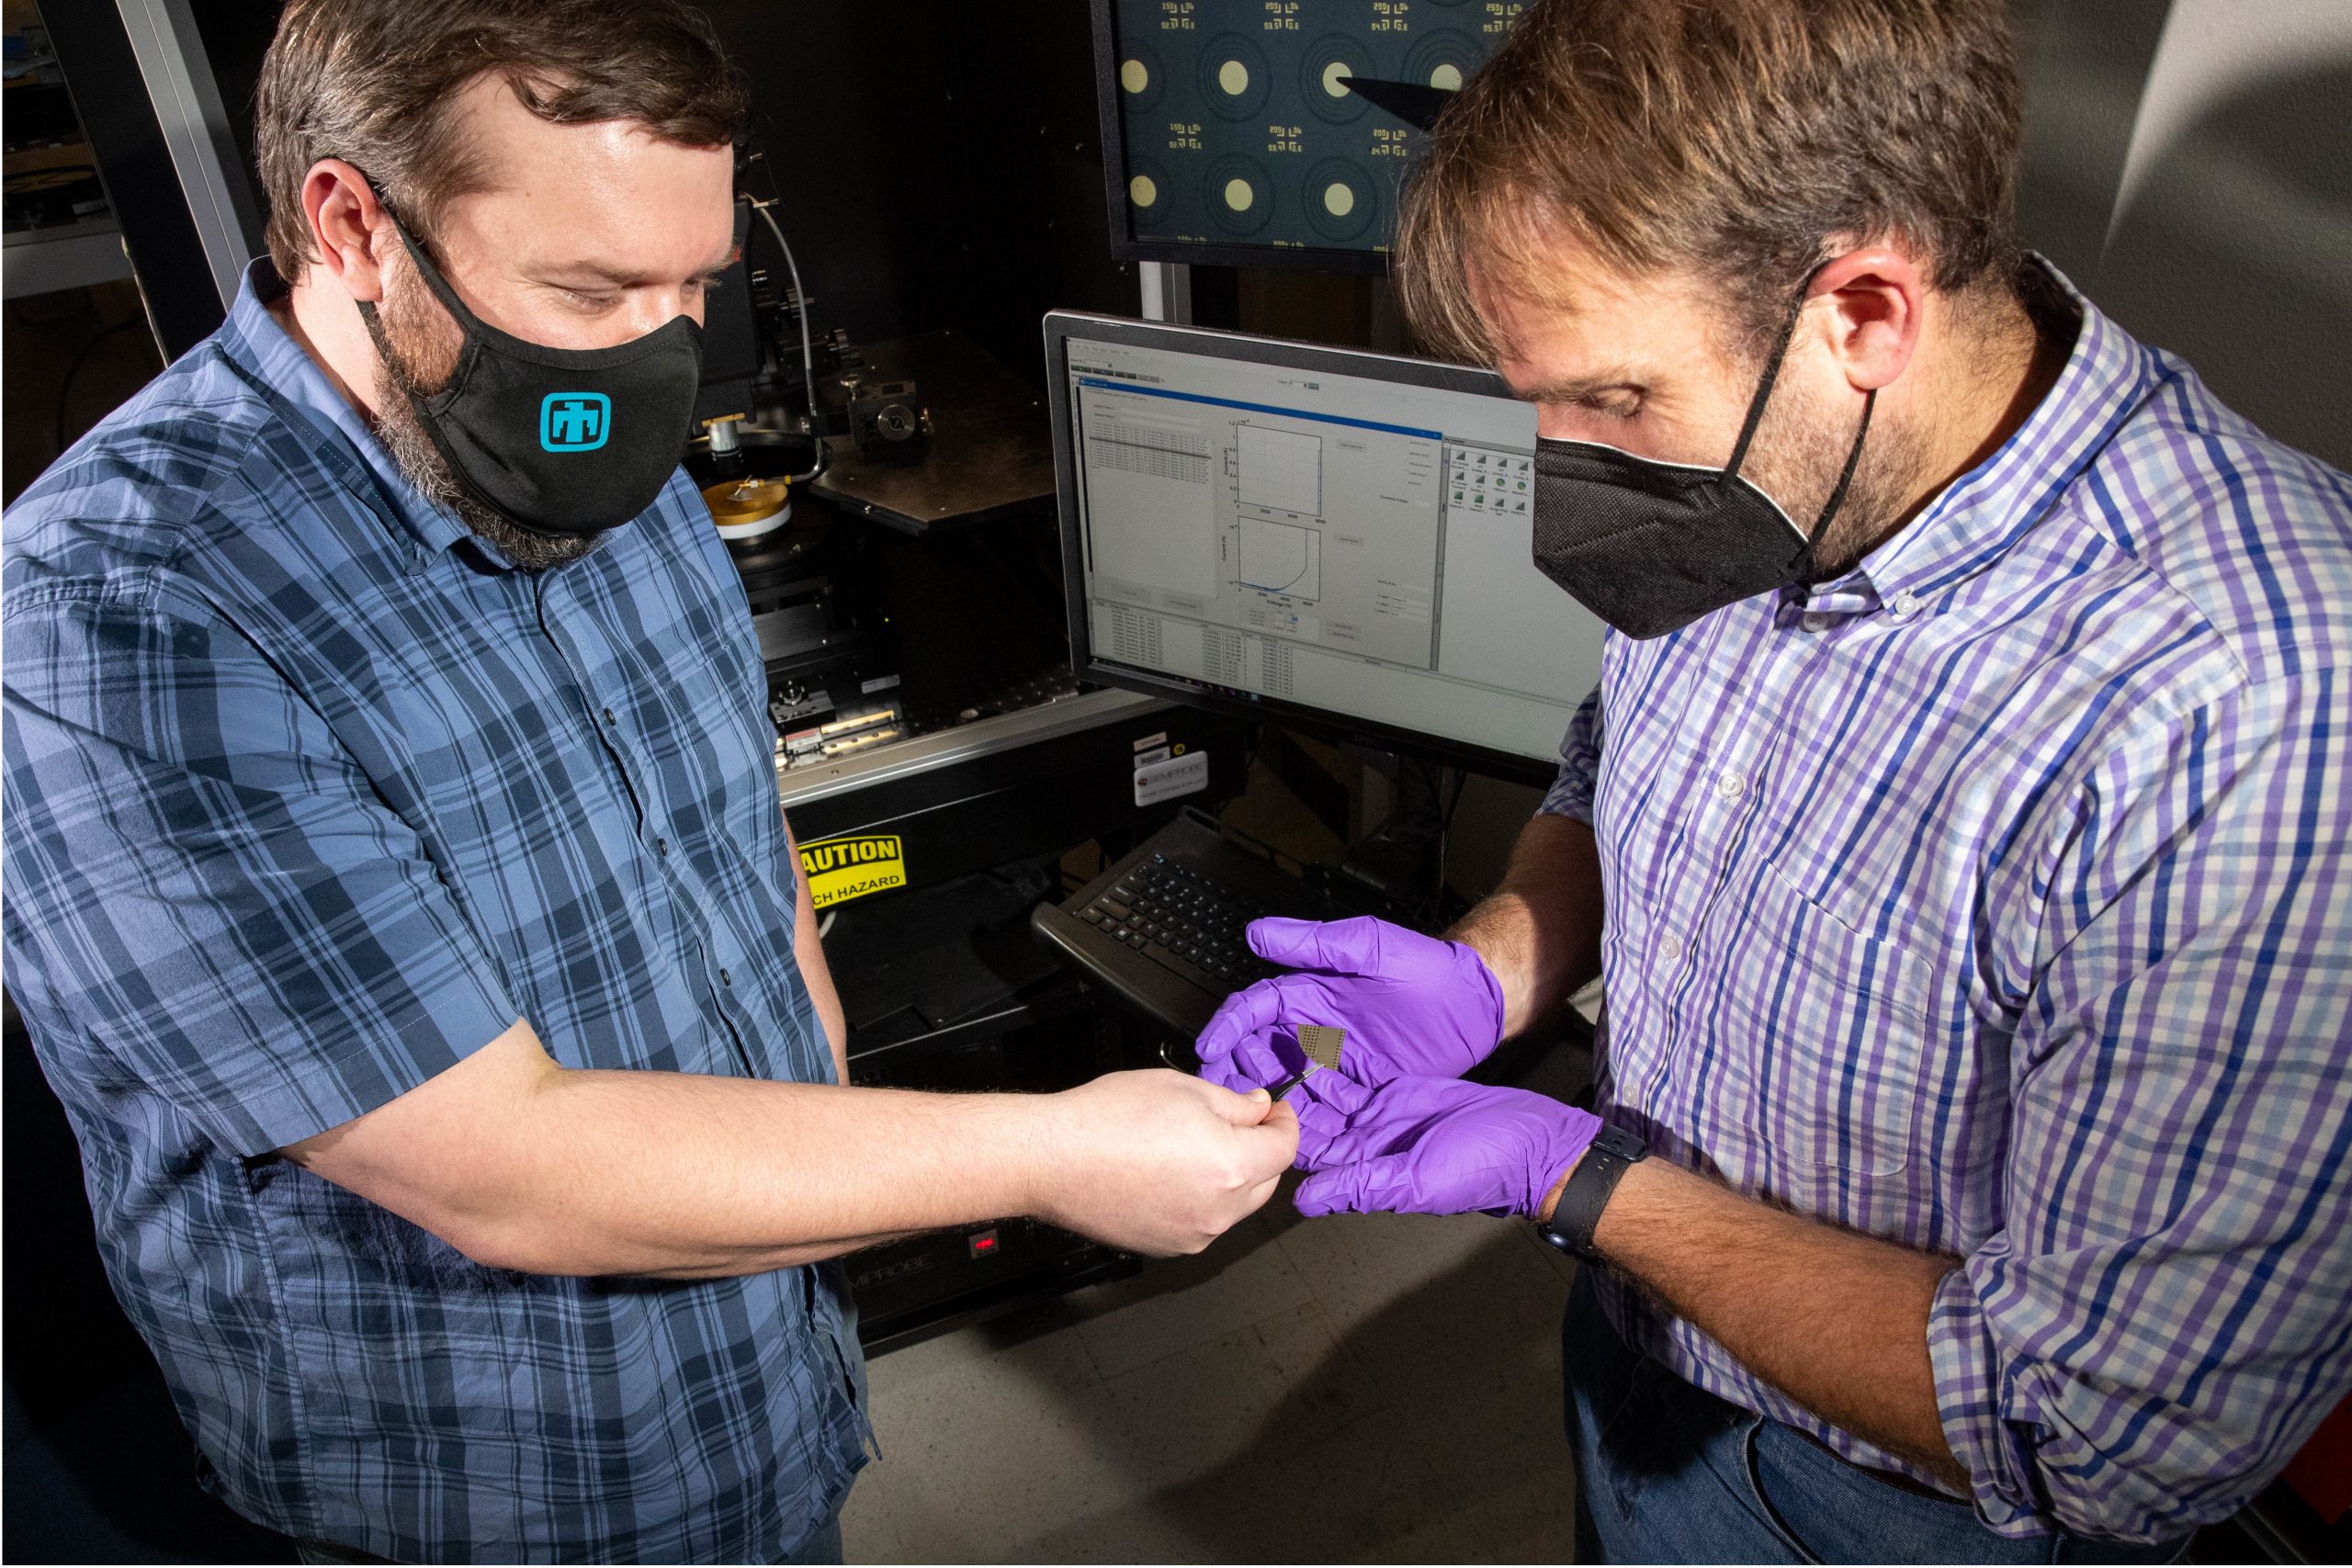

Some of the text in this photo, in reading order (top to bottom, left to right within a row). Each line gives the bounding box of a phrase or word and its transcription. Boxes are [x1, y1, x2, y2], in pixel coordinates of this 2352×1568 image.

[800, 840, 896, 874] AUTION
[812, 874, 900, 906] CH HAZARD
[853, 1255, 933, 1288] MIPROBE
